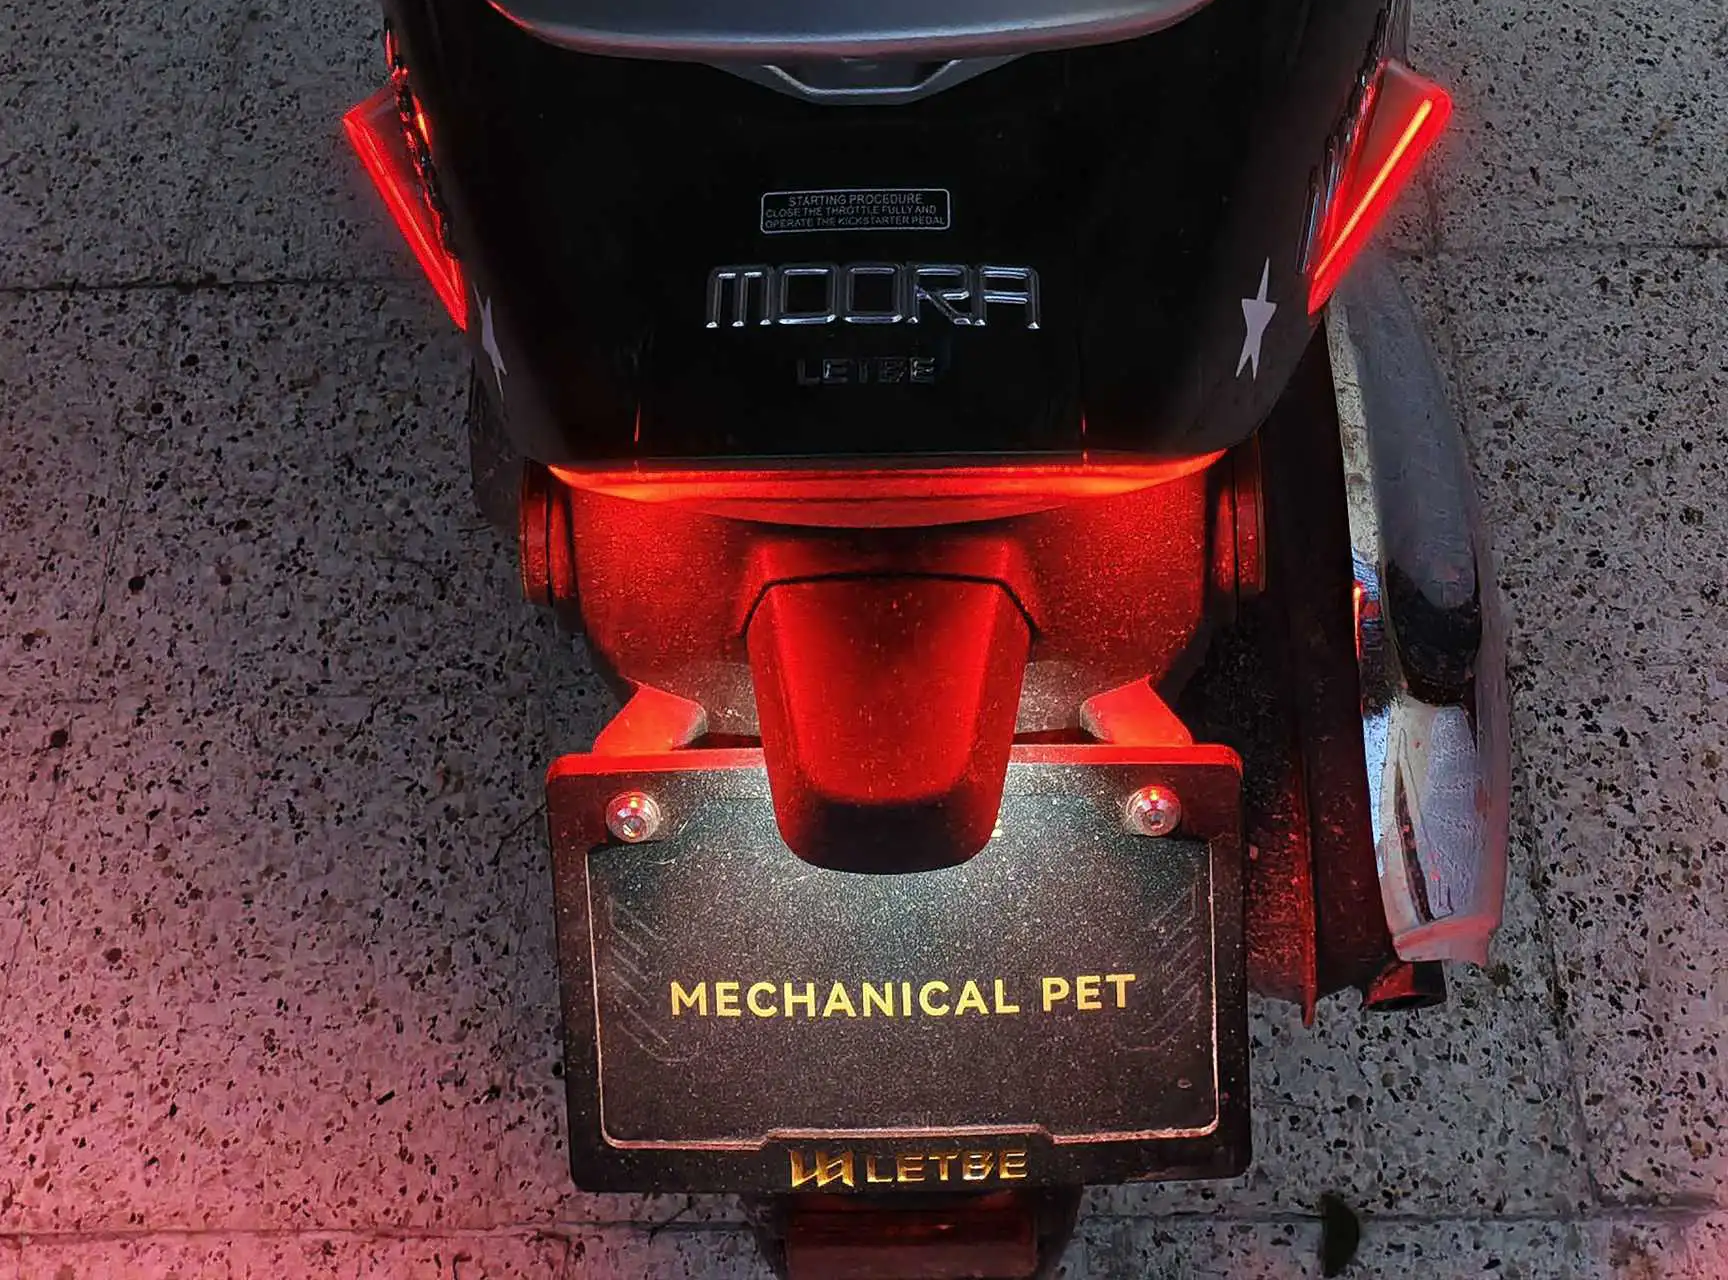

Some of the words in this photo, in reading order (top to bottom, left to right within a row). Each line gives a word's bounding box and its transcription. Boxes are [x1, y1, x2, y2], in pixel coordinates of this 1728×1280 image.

[765, 208, 800, 218] CLOSE
[804, 207, 823, 217] THE
[825, 206, 880, 216] THROTTLE
[881, 205, 913, 215] FULLY
[914, 204, 937, 214] AND
[788, 194, 847, 207] STARTING
[849, 193, 924, 205] PROCEDURE
[765, 218, 814, 229] OPERATE
[816, 217, 836, 227] THE
[837, 215, 910, 226] KICKSTARTER
[911, 215, 945, 225] PEDAL
[706, 263, 1041, 329] MOORA
[669, 978, 1020, 1018] MECHANICAL
[1041, 973, 1136, 1012] PET
[866, 1151, 1028, 1183] LETBE
